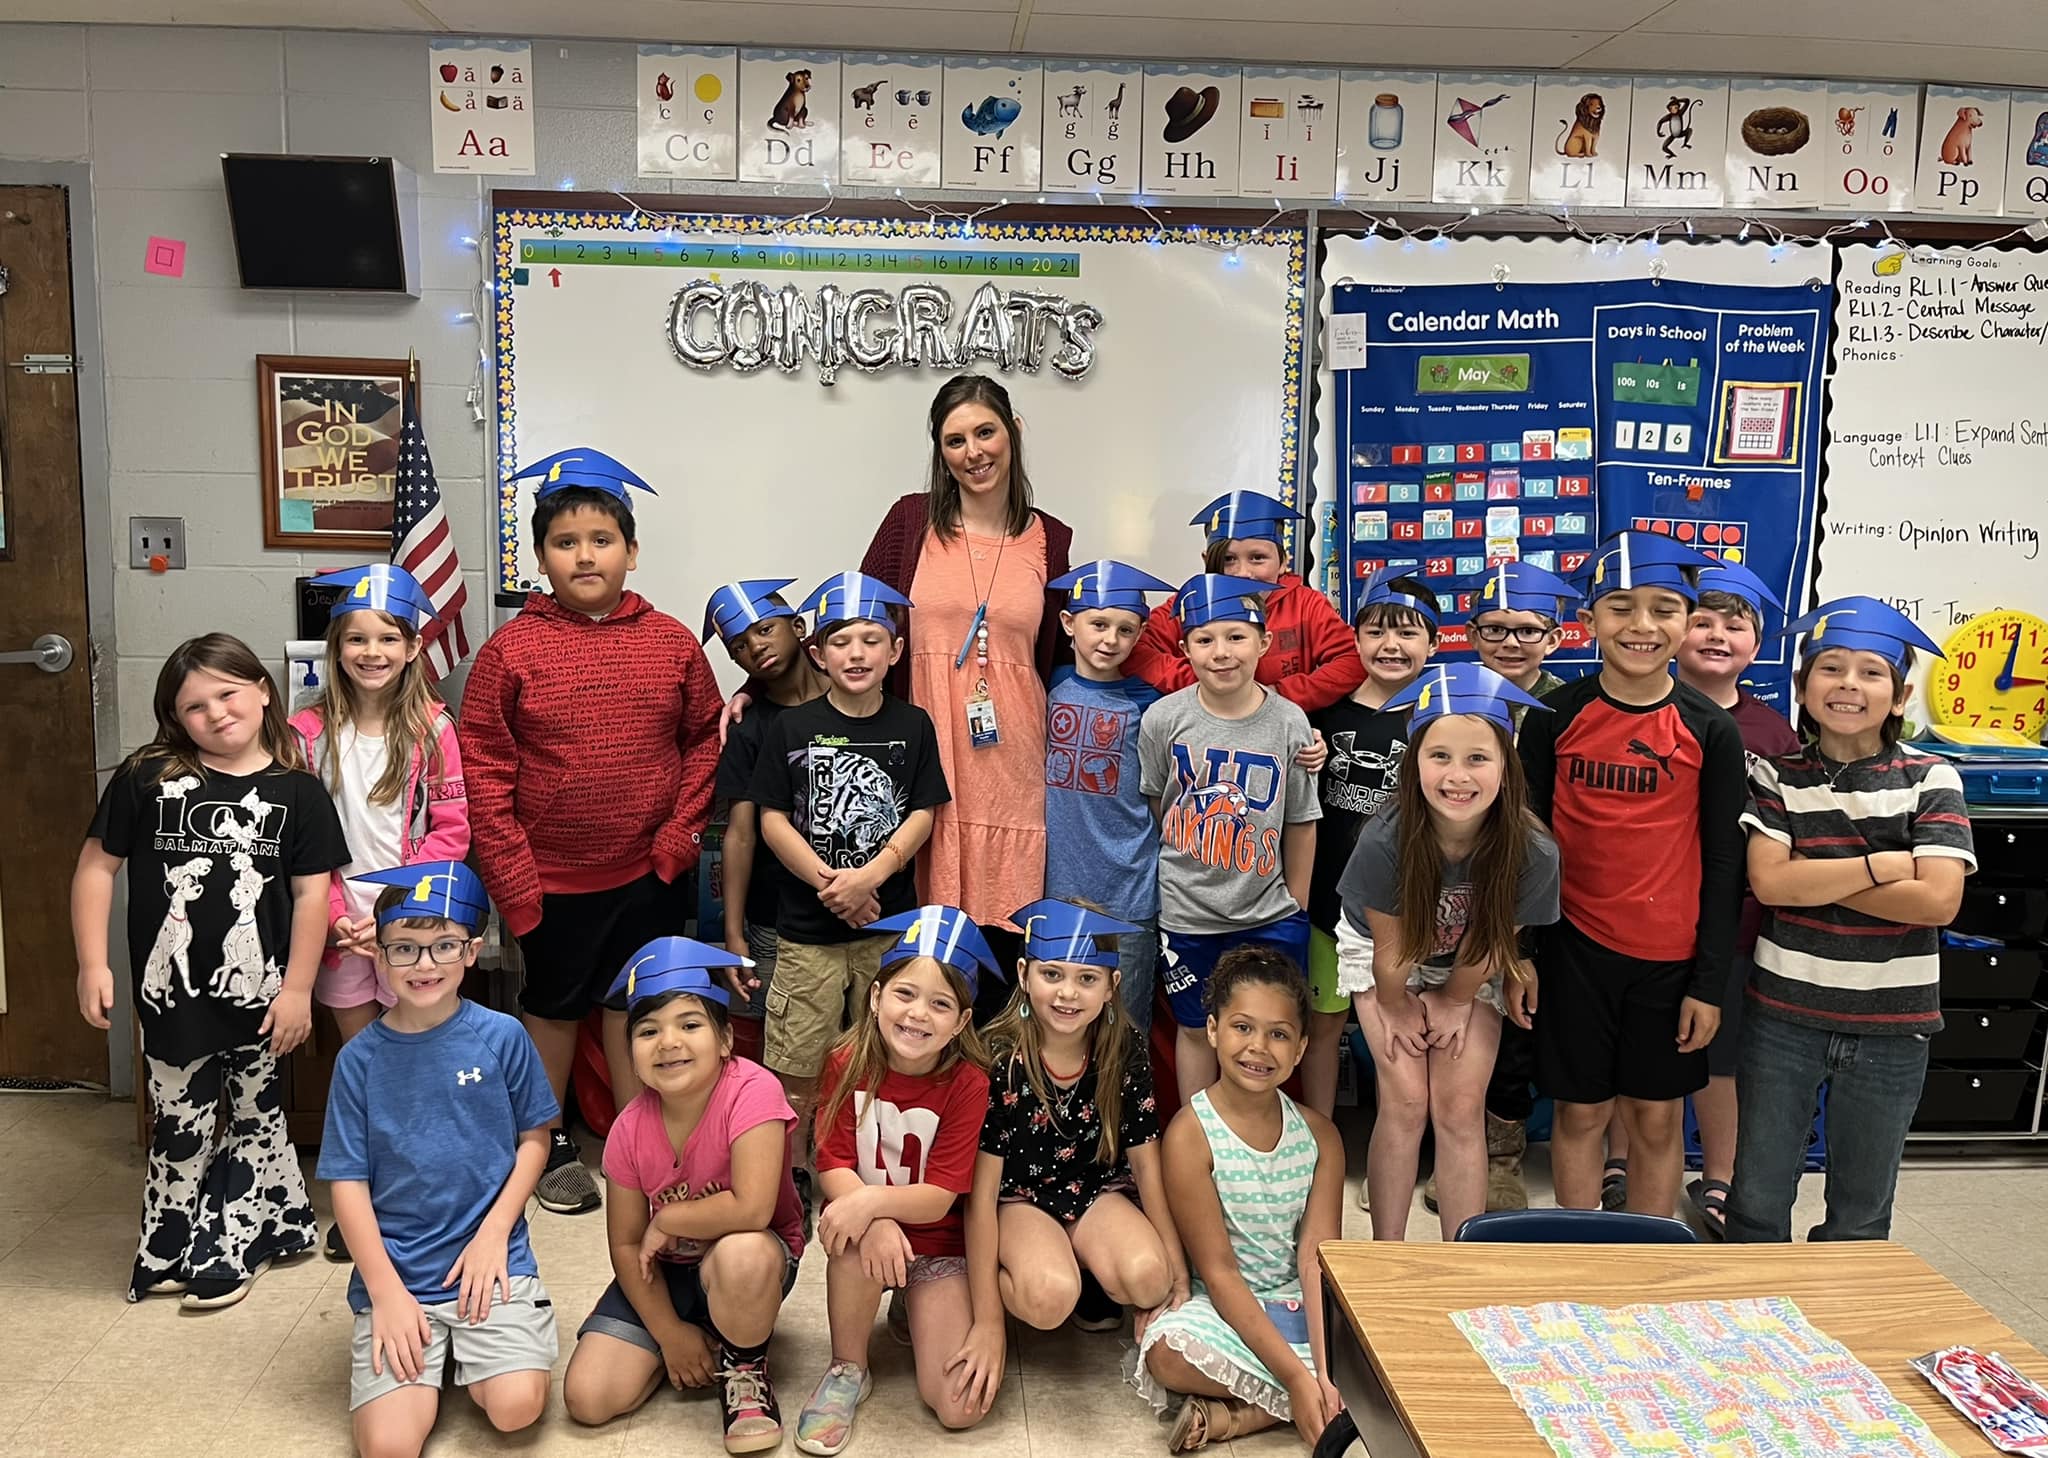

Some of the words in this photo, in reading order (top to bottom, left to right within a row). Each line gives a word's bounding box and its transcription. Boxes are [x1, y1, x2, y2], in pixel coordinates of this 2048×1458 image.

[457, 129, 510, 157] Aa
[665, 134, 712, 163] Cc
[764, 138, 815, 168] Dd
[868, 142, 914, 170] Ee
[973, 145, 1013, 174] Ff
[1067, 149, 1117, 184] Gg
[1164, 152, 1217, 179] Hh
[1275, 154, 1299, 181] Ii
[1364, 157, 1400, 192] Jj
[1455, 159, 1507, 188] Kk
[1559, 162, 1596, 190] Ll
[1642, 164, 1709, 190] Mm
[1747, 166, 1800, 192] Nn
[1843, 168, 1889, 196] Oo
[1936, 171, 1980, 206] Pp
[524, 246, 534, 258] 0
[552, 245, 557, 259] 1
[577, 244, 585, 258] 2
[603, 246, 611, 260] 3
[627, 246, 637, 260] 4
[680, 248, 689, 262] 6
[706, 249, 715, 263] 7
[731, 250, 740, 264] 8
[757, 250, 766, 264] 9
[779, 251, 795, 265] 10
[808, 252, 819, 265] 11
[831, 252, 846, 267] 12
[857, 253, 872, 267] 13
[882, 253, 897, 268] 14
[933, 254, 948, 269] 16
[958, 255, 973, 270] 17
[984, 256, 998, 271] 18
[1009, 257, 1024, 271] 19
[1032, 257, 1051, 272] 20
[1060, 258, 1074, 273] 21
[1844, 281, 1901, 298] Reading
[1388, 309, 1490, 332] Calendar
[1496, 307, 1559, 330] Math
[1906, 299, 1965, 319] Central
[1975, 296, 2035, 319] Message
[665, 279, 1104, 383] CONGRATS
[1607, 324, 1643, 339] Days
[1645, 323, 1656, 337] in
[1659, 324, 1707, 341] School
[1738, 324, 1793, 337] Problem
[1909, 323, 1974, 342] Describe
[1725, 339, 1740, 353] of
[1743, 340, 1765, 353] the
[1767, 340, 1805, 353] Week
[1458, 367, 1490, 385] May
[324, 399, 358, 423] IN
[1361, 405, 1386, 414] Sunday
[1395, 405, 1420, 414] Monday
[1427, 404, 1453, 413] Tuesday
[1456, 402, 1489, 412] Wednesday
[1491, 402, 1520, 412] Thursday
[1528, 401, 1549, 411] Friday
[1558, 400, 1588, 409] Saturday
[296, 421, 373, 447] GOD
[1645, 429, 1653, 443] 2
[1673, 431, 1682, 445] 6
[1955, 419, 2015, 448] Expand
[316, 447, 369, 472] WE
[1437, 448, 1446, 459] 2
[1465, 447, 1475, 459] 3
[1501, 445, 1510, 457] 4
[1533, 445, 1541, 457] 5
[1869, 446, 1925, 468] Context
[1938, 445, 1972, 466] Clues
[287, 468, 396, 495] TRUST
[1462, 472, 1478, 480] Today
[1647, 472, 1731, 489] Ten-Frames
[1367, 487, 1376, 499] 7
[1434, 486, 1442, 497] 9
[1464, 485, 1478, 497] 10
[1533, 481, 1546, 494] 12
[1565, 480, 1580, 492] 13
[1400, 524, 1414, 536] 15
[1432, 524, 1445, 535] 16
[1462, 522, 1475, 535] 17
[1531, 519, 1545, 532] 19
[1562, 517, 1579, 530] 20
[1899, 518, 1969, 550] Opinion
[1979, 520, 2039, 559] Writing
[1431, 560, 1447, 572] 23
[1462, 559, 1479, 571] 24
[1566, 555, 1585, 569] 27
[1976, 630, 1994, 648] 11
[2029, 629, 2038, 647] 1
[1956, 651, 1976, 669] 10
[1948, 673, 1961, 691] 9
[1952, 697, 1965, 714] 8
[2033, 698, 2046, 715] 4
[1969, 714, 1982, 727] 7
[2013, 714, 2025, 731] 5
[1569, 756, 1658, 793] PUMA
[813, 754, 835, 835] READY
[1327, 778, 1389, 804] UNDE
